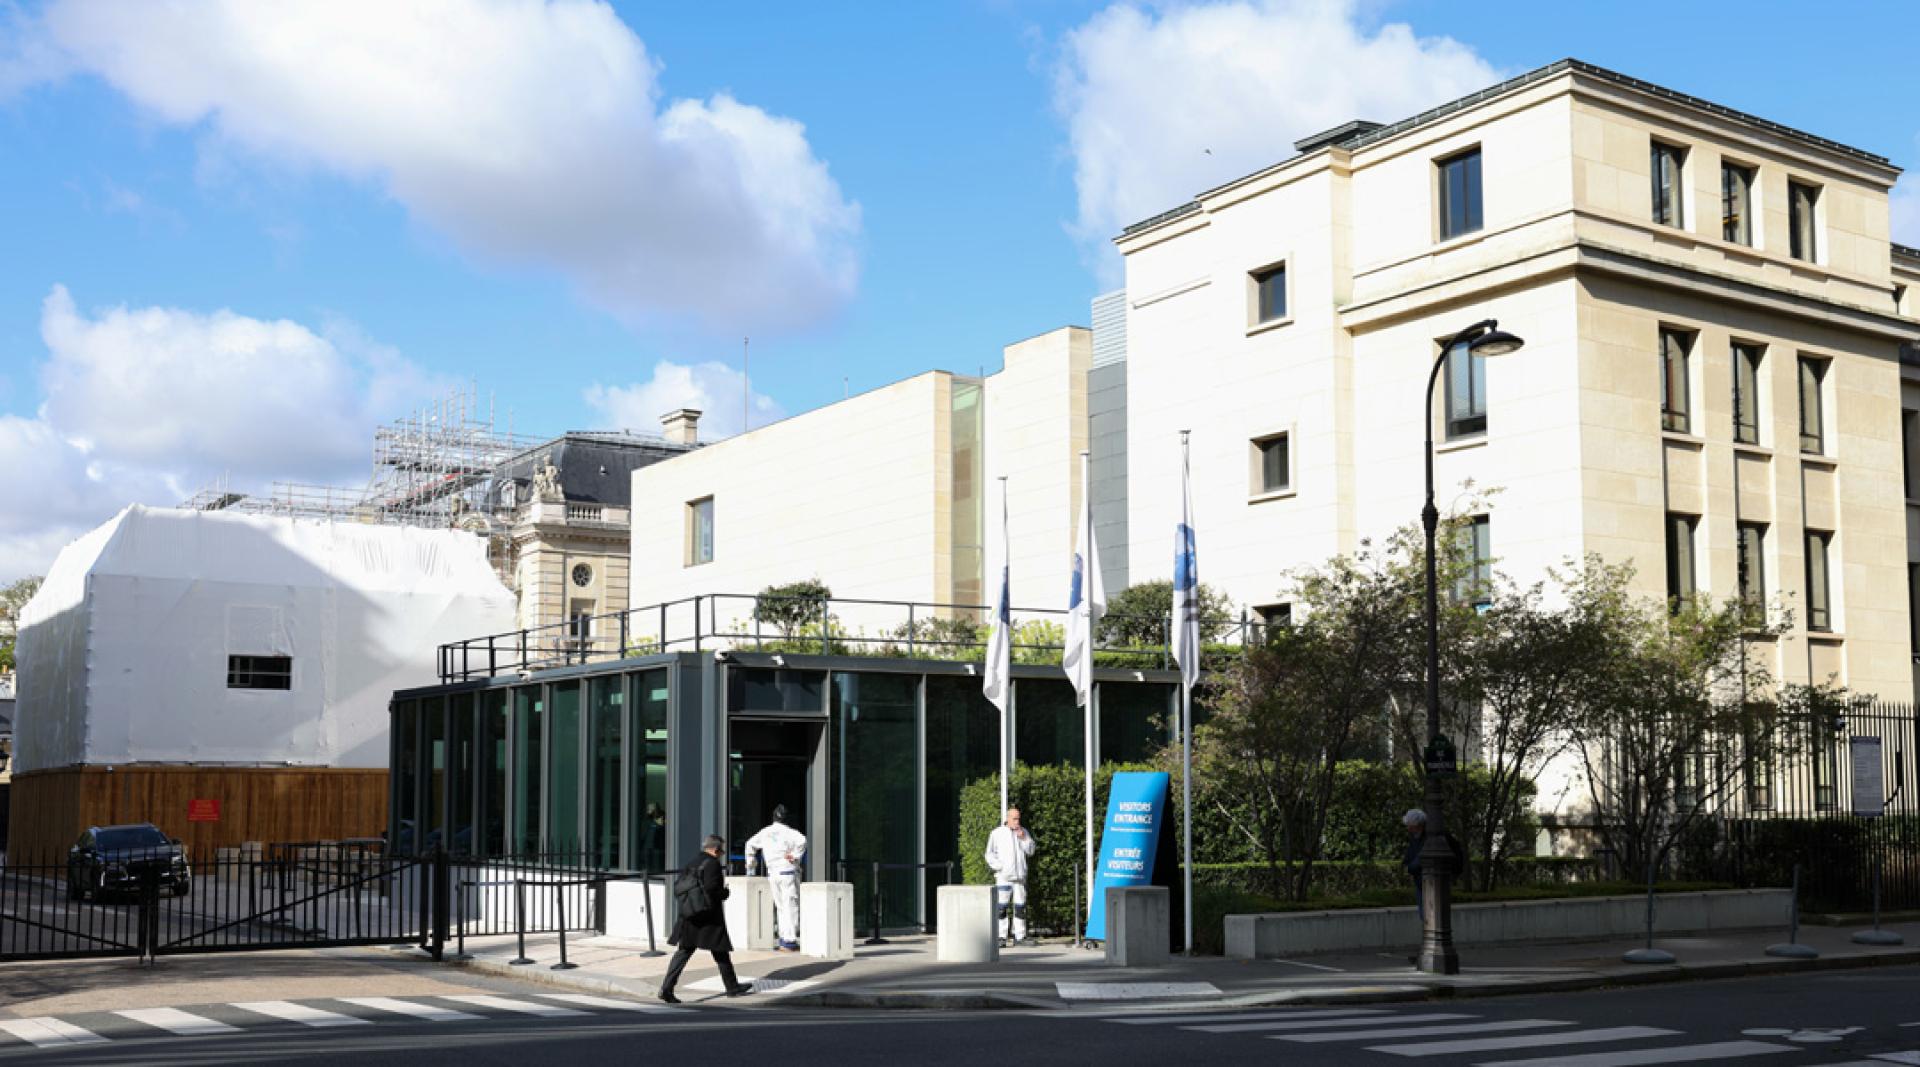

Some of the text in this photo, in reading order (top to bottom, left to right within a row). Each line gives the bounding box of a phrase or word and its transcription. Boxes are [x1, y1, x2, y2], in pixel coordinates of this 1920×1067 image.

[1119, 801, 1152, 812] VISITORS
[1114, 813, 1152, 825] ENTRANCE
[1108, 860, 1144, 871] VISITEURS
